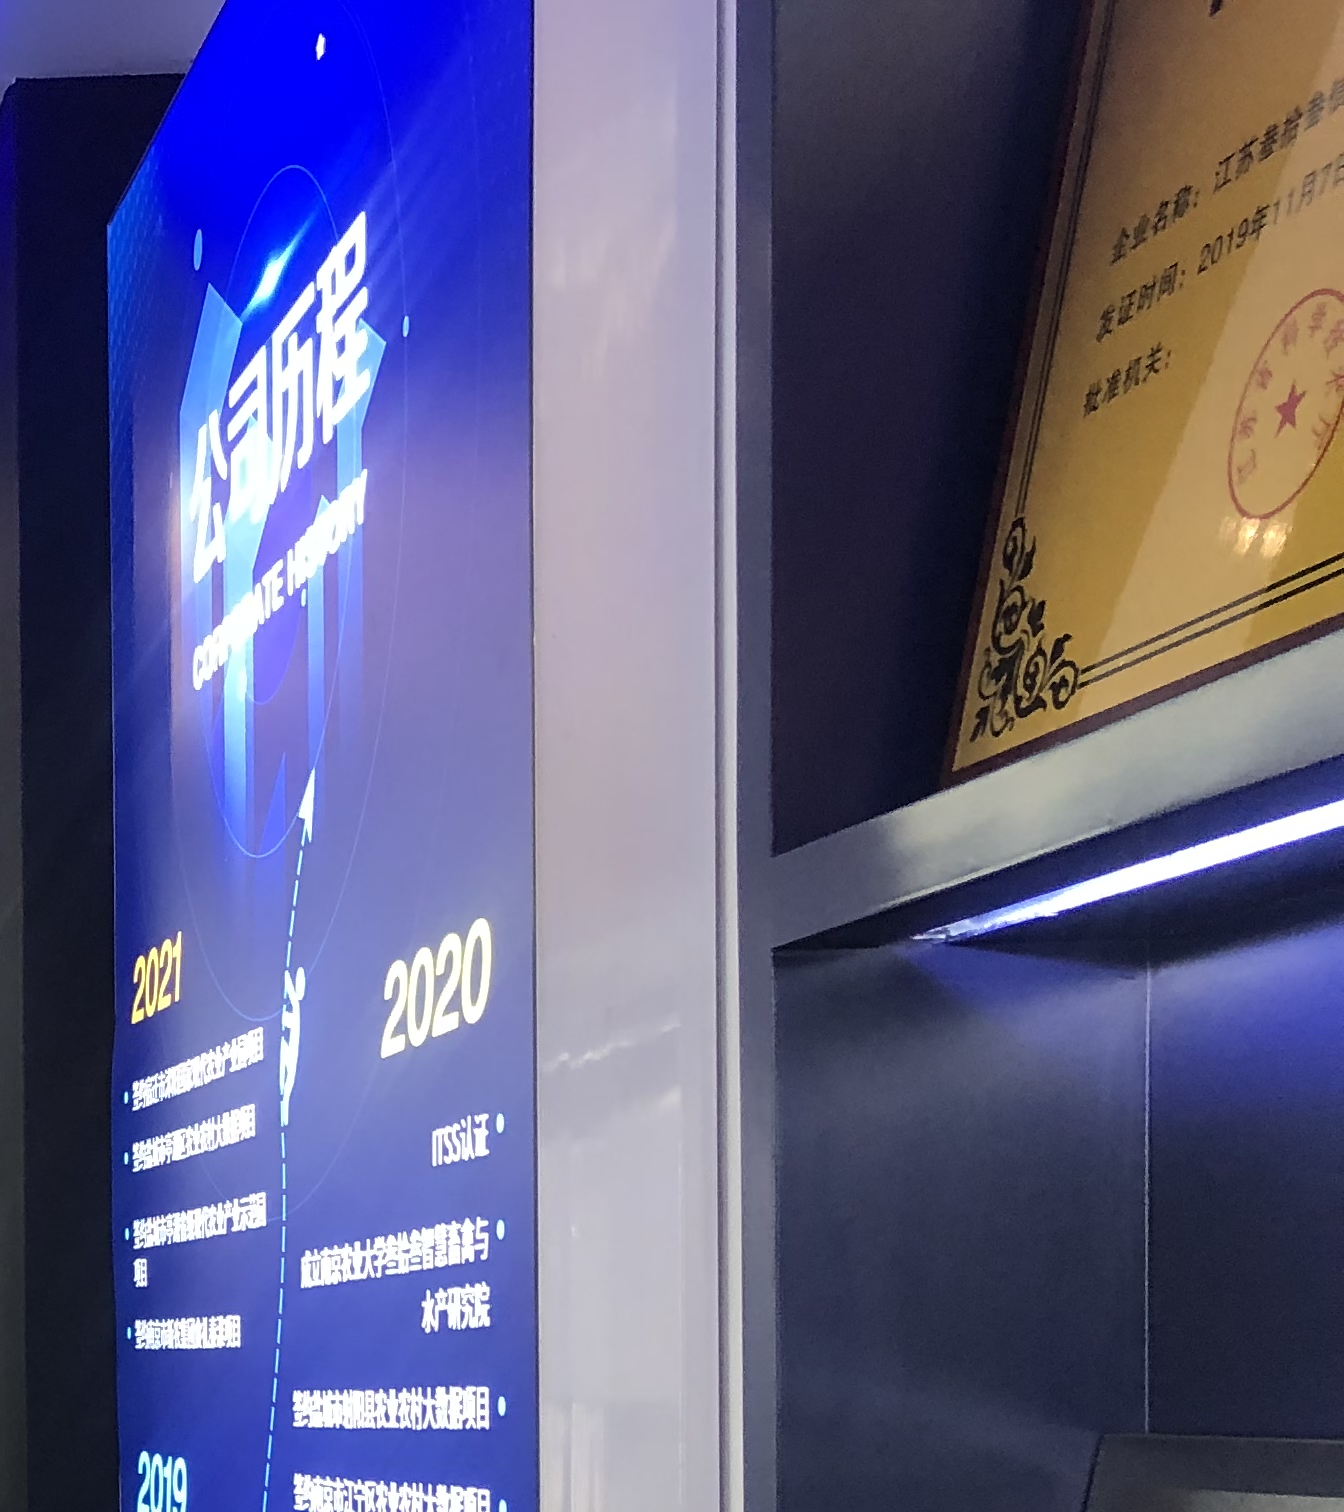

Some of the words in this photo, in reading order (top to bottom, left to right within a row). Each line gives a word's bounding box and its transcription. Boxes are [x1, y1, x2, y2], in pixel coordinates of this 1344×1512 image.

[189, 211, 369, 584] 公司历程
[132, 931, 182, 1024] 2021
[380, 918, 492, 1058] 2020
[432, 1113, 489, 1166] ITSS认证
[422, 1281, 490, 1333] 水产研究院
